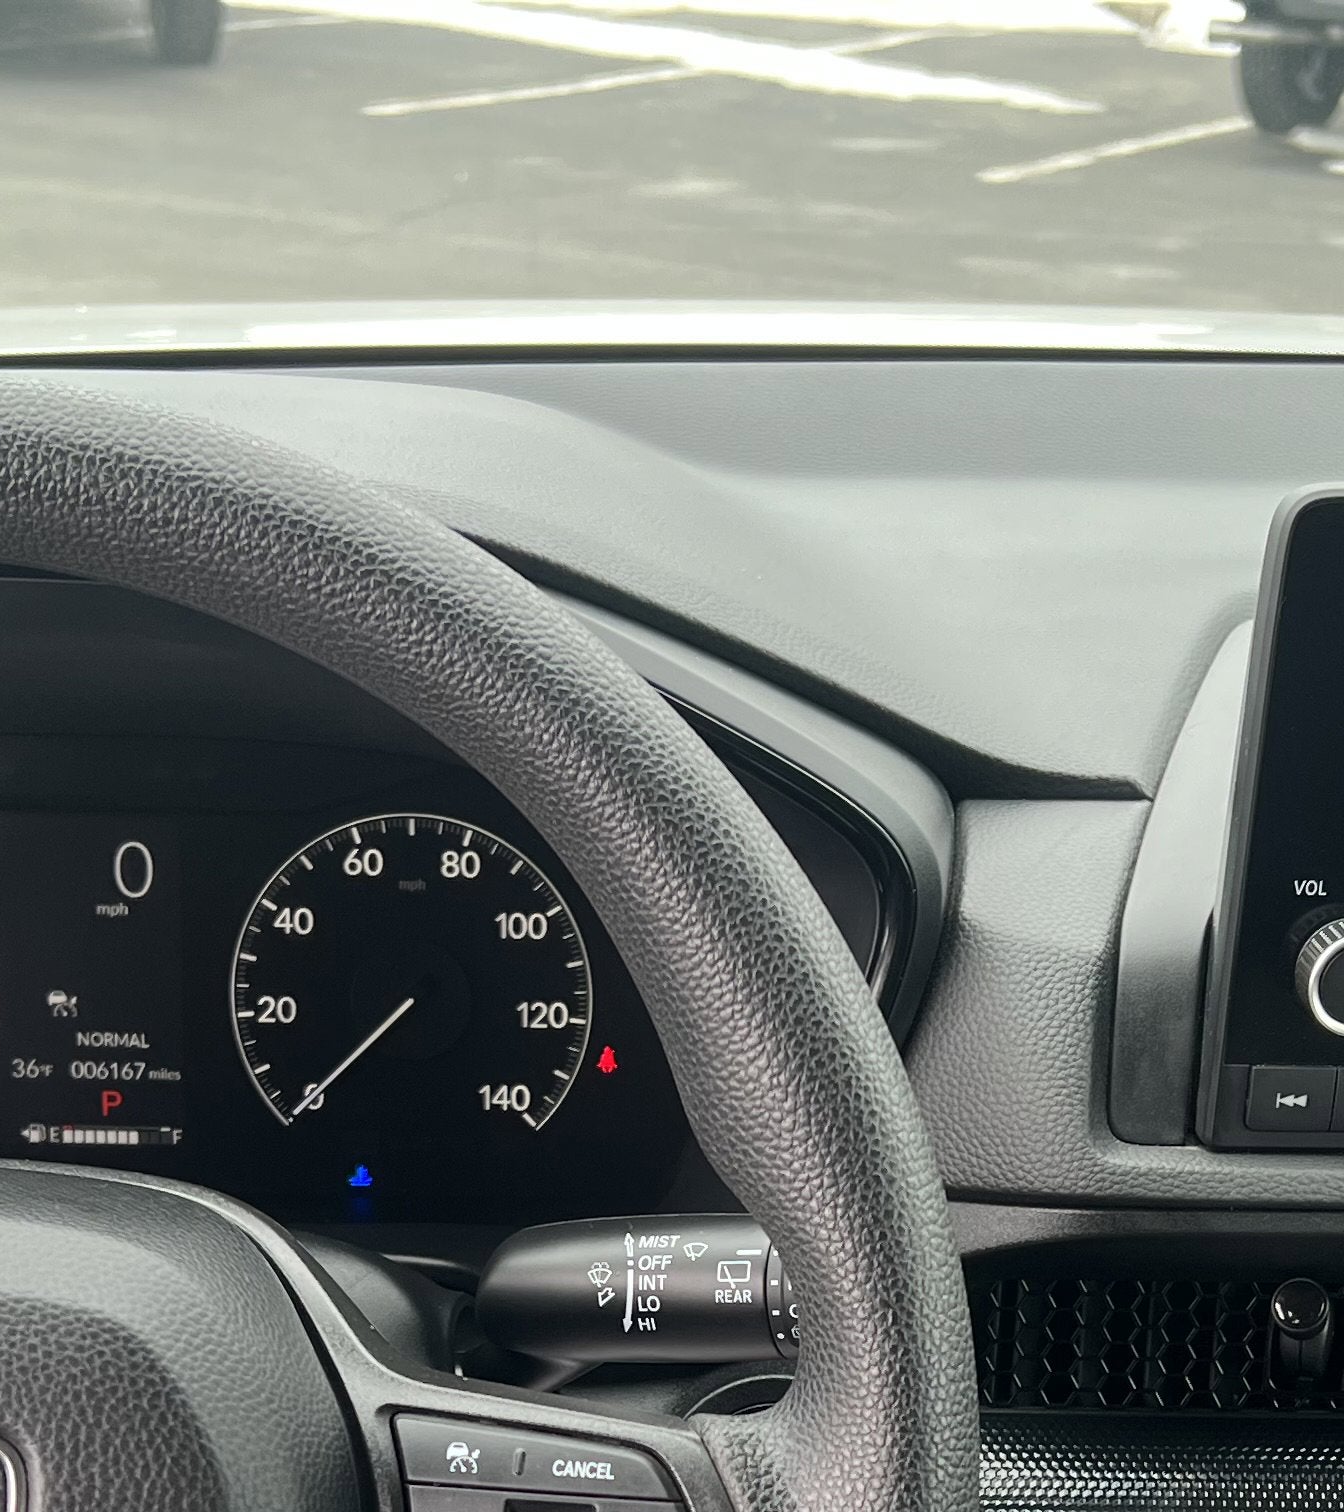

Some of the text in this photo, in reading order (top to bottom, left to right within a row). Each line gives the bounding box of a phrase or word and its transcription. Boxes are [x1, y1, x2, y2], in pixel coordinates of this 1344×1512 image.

[114, 842, 153, 899] 0
[342, 848, 384, 877] 60
[440, 850, 481, 879] 80
[398, 878, 427, 893] mph
[1294, 879, 1327, 897] VOL
[96, 902, 129, 918] mph
[272, 907, 315, 936] 40
[495, 912, 548, 941] 100
[257, 995, 298, 1025] 20
[516, 1001, 569, 1030] 120
[76, 1032, 150, 1049] NORMAL
[70, 1060, 146, 1081] 006167
[149, 1067, 182, 1081] miles
[101, 1091, 122, 1116] P
[477, 1084, 531, 1112] 140
[49, 1127, 60, 1142] E
[173, 1128, 183, 1144] F
[638, 1234, 681, 1249] MIST
[638, 1255, 673, 1271] OFF
[638, 1274, 668, 1291] INT
[637, 1296, 661, 1312] LO
[715, 1289, 753, 1305] REAR
[637, 1317, 657, 1332] HI
[552, 1459, 615, 1481] CANCEL
